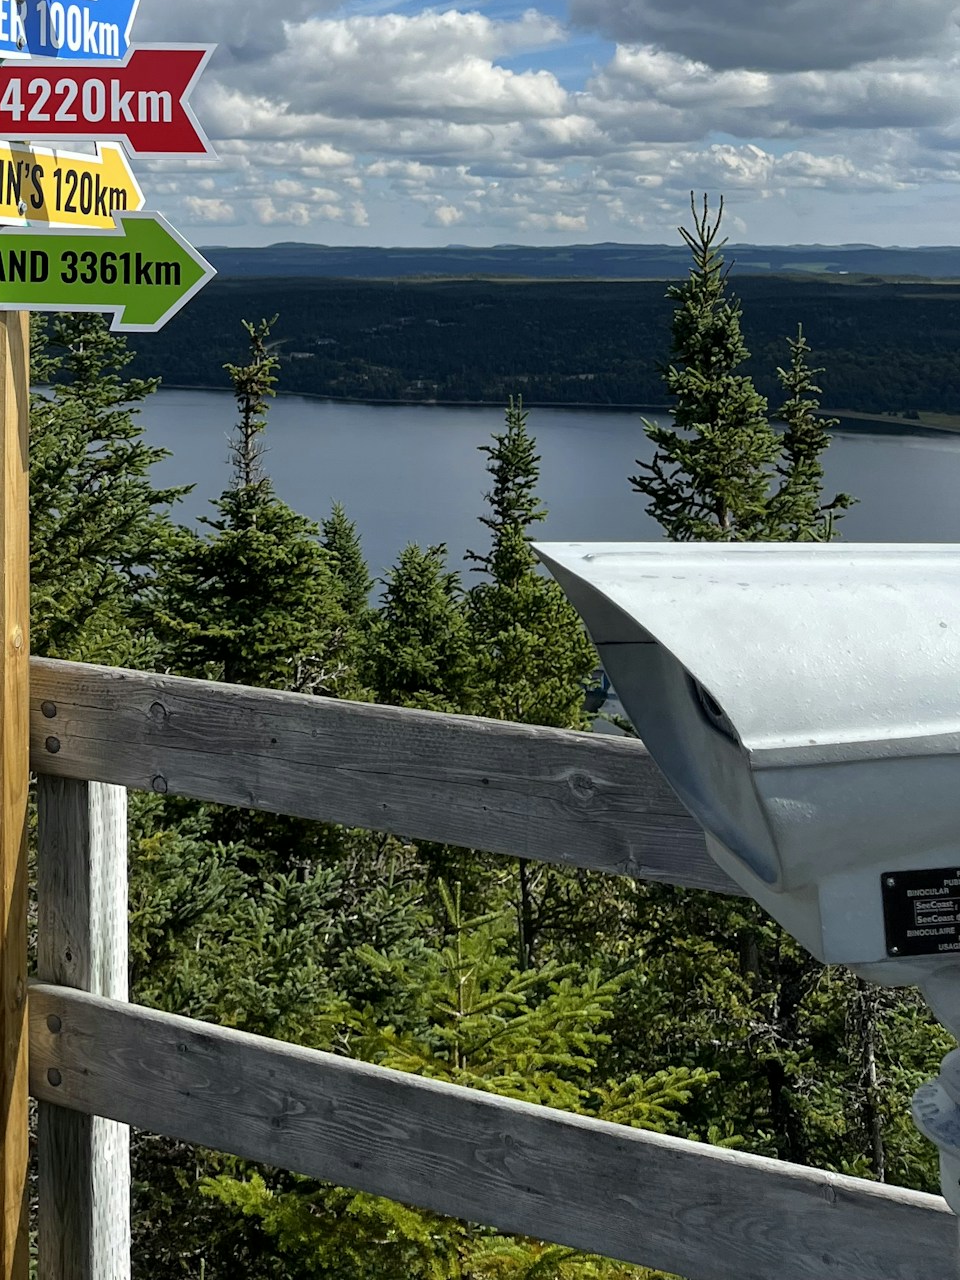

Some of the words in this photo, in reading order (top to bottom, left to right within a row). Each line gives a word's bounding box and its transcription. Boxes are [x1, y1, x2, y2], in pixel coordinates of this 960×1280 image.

[37, 0, 120, 57] 100km
[0, 78, 173, 123] 4220km
[53, 167, 127, 218] 120km
[61, 251, 181, 287] 3361km
[907, 888, 949, 897] BINOCULAR
[916, 901, 954, 909] SeeCoast
[917, 915, 955, 924] SeeCoast
[907, 927, 955, 937] BINOCULAIRE
